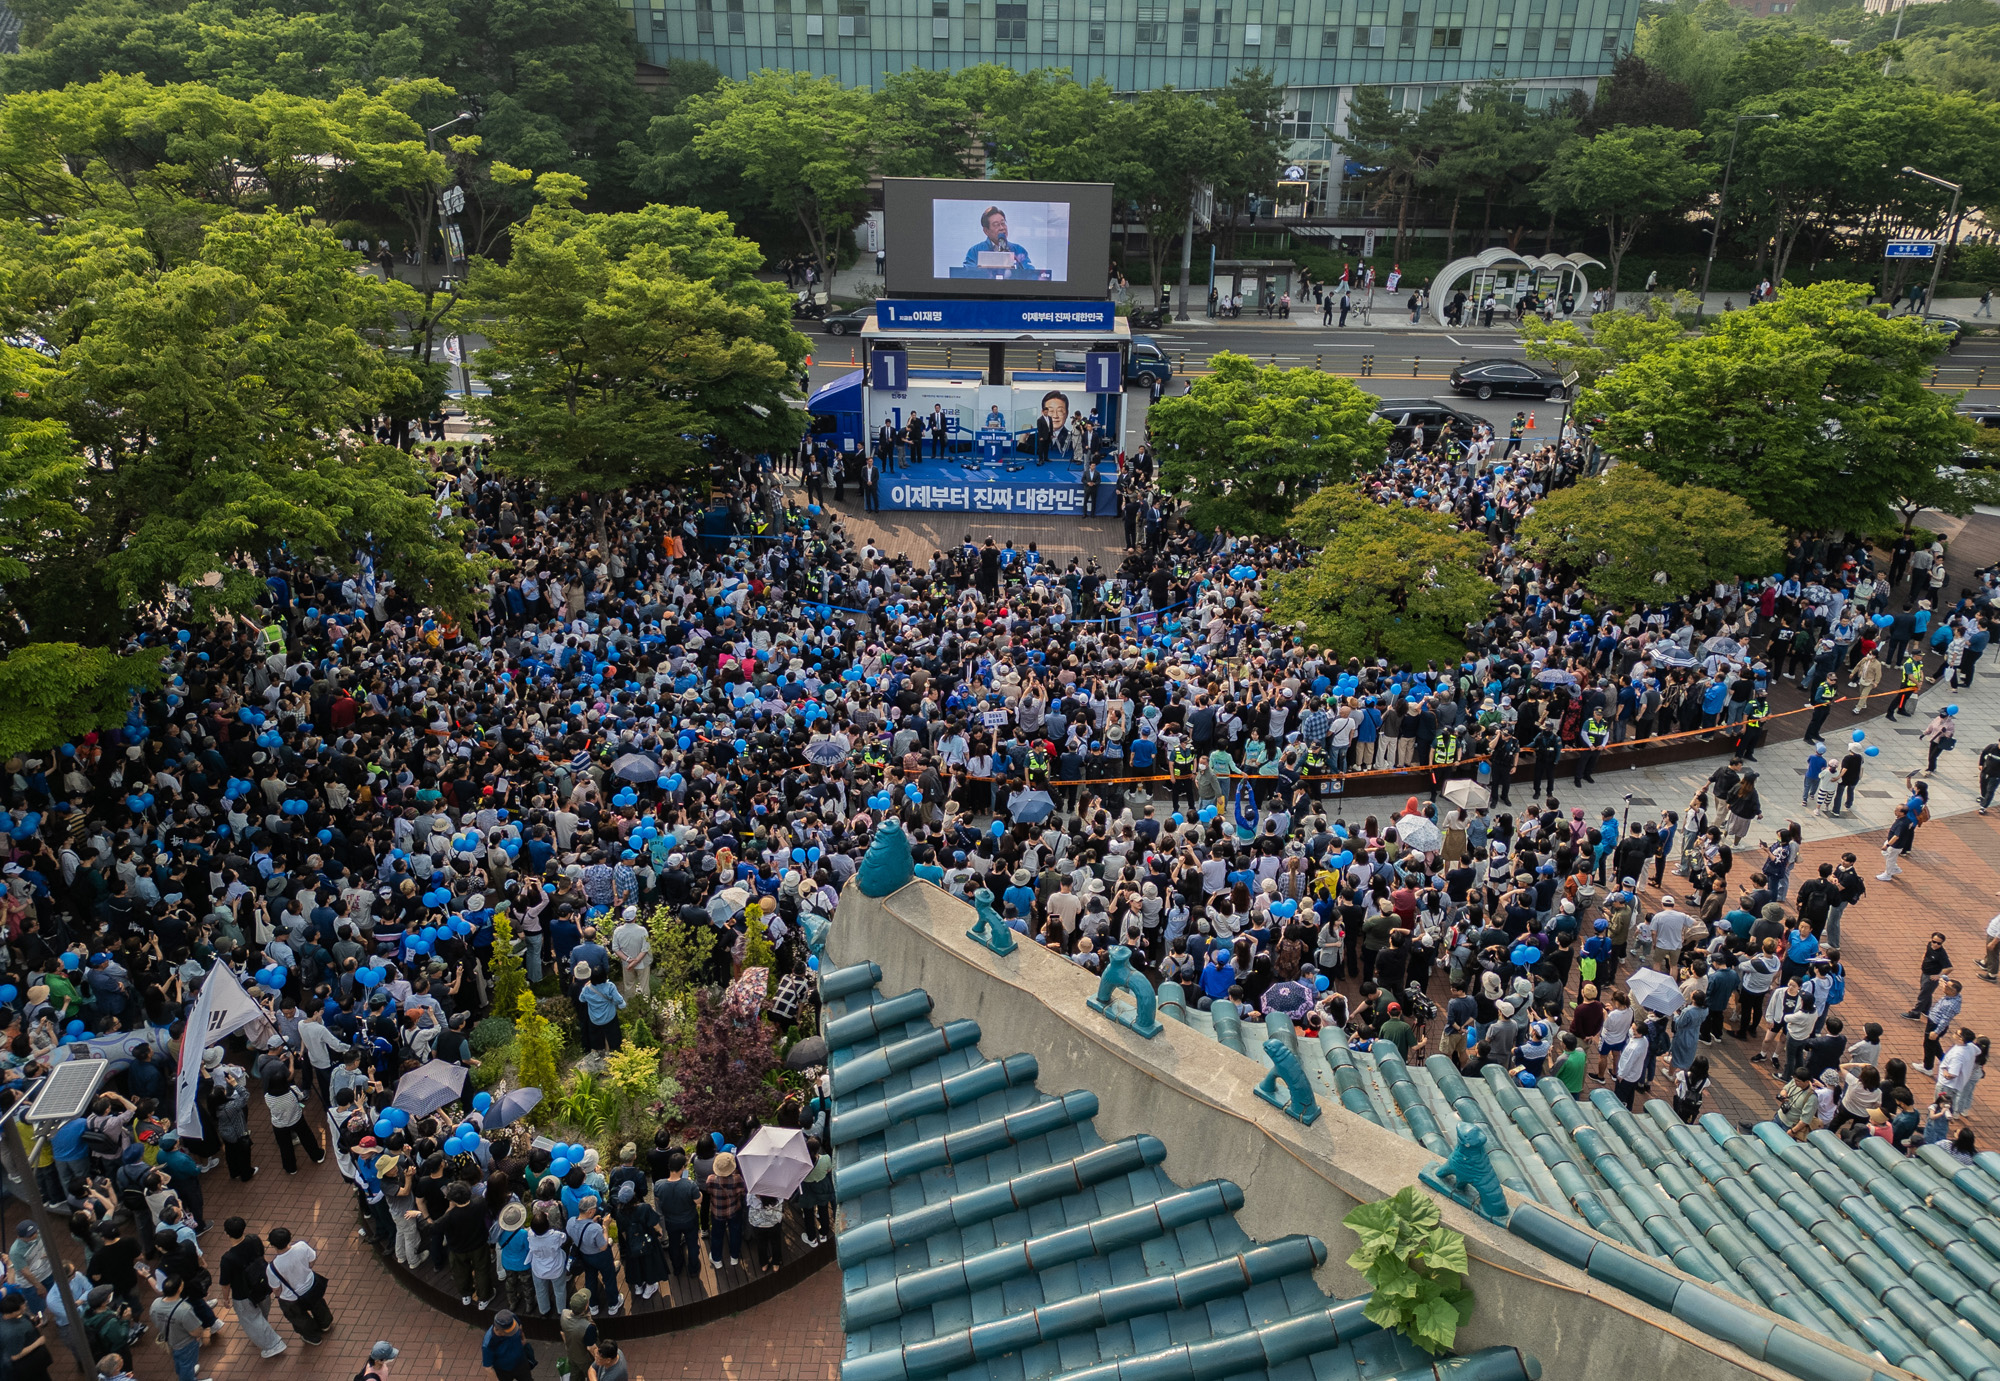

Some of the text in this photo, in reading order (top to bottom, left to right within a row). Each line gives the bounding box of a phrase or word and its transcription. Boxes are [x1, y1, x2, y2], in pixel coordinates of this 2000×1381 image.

[888, 306, 895, 321] 1
[912, 311, 942, 322] 이재명
[1022, 312, 1104, 323] 이제부터 진짜 대한민국
[884, 355, 895, 386] 1
[1098, 357, 1109, 388] 1
[891, 407, 901, 433] 1
[891, 484, 970, 509] 이제부터
[973, 486, 1013, 511] 진짜
